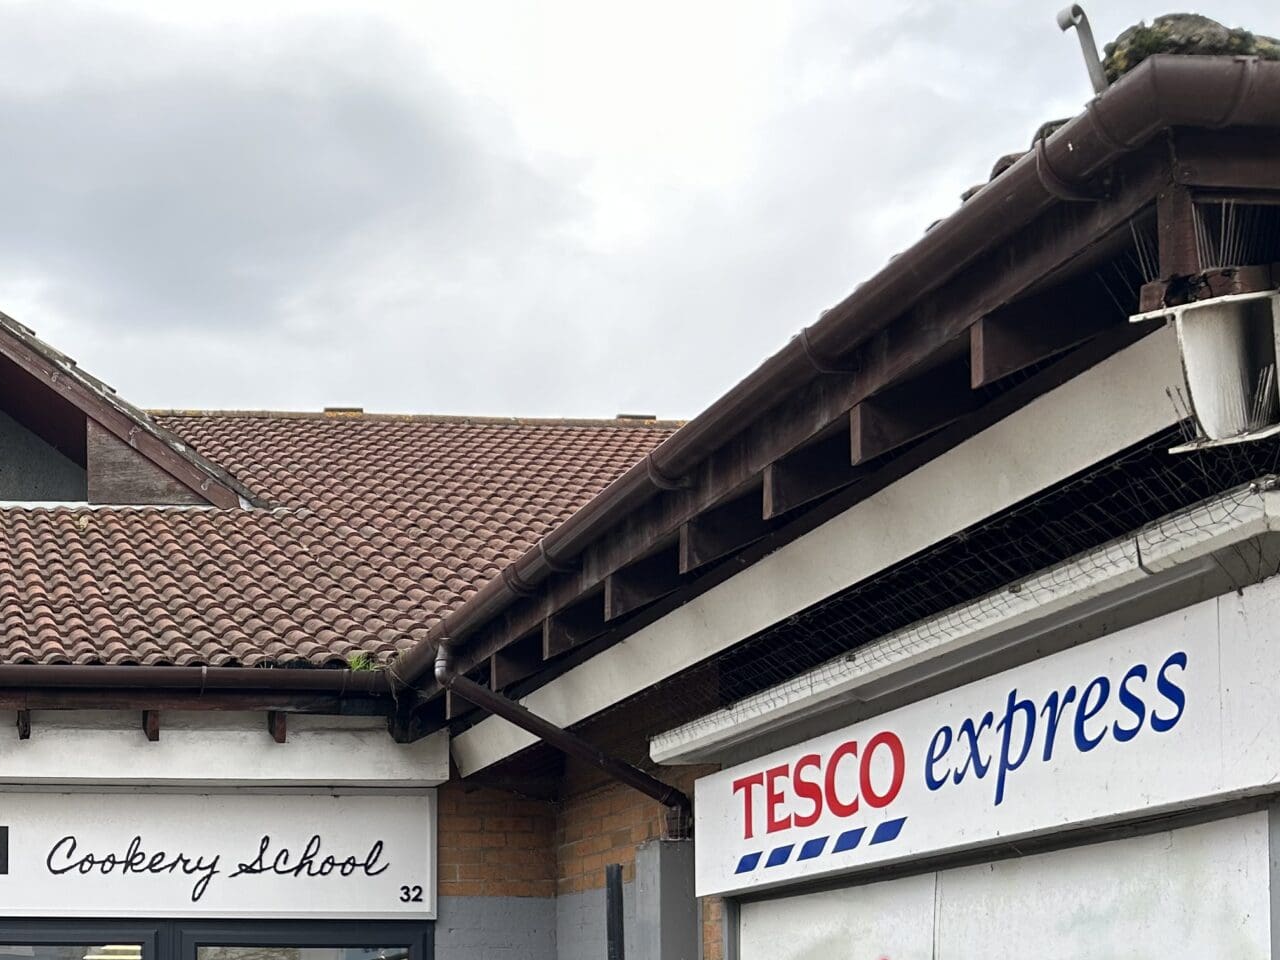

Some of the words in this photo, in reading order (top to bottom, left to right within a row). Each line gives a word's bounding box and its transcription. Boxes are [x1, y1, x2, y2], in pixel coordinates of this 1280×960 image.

[733, 730, 906, 840] TESCO
[924, 650, 1188, 806] express
[46, 836, 221, 902] Cookery
[228, 835, 391, 878] School
[399, 885, 424, 903] 32
